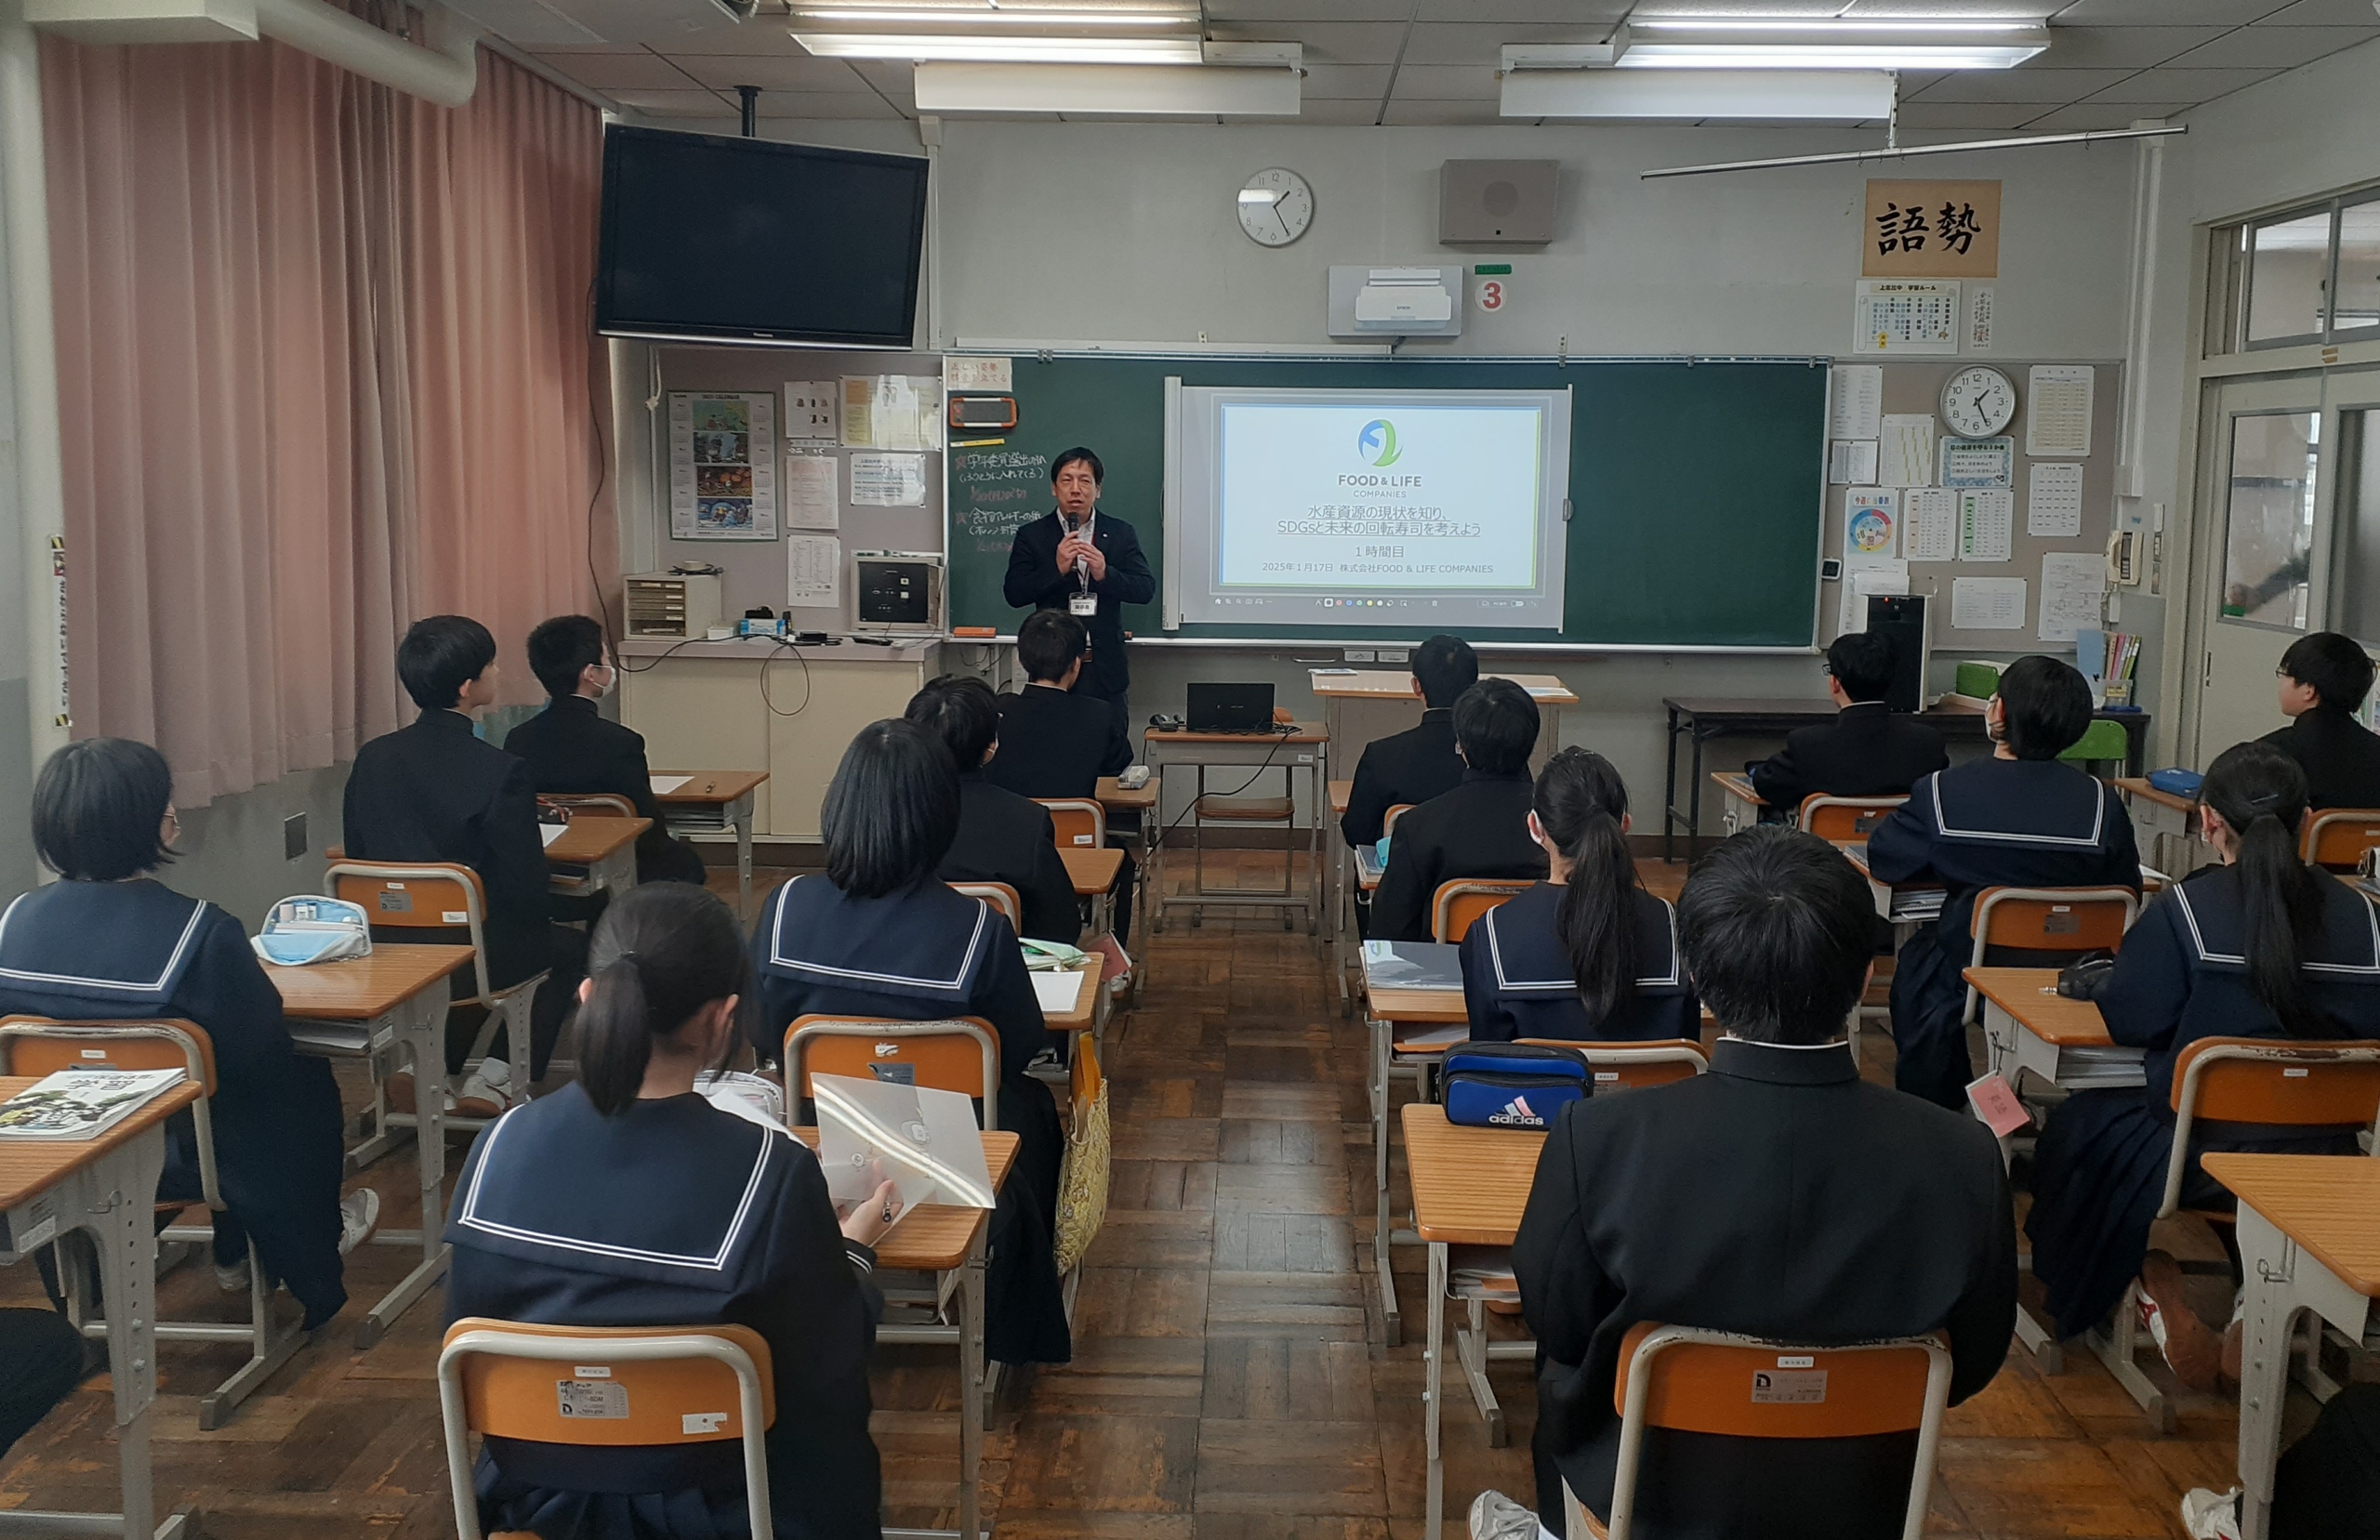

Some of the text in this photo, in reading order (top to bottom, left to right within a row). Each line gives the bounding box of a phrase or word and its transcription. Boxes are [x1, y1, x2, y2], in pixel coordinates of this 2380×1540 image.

[1272, 173, 1280, 182] 12
[1297, 188, 1303, 197] 2
[1302, 204, 1307, 212] 3
[1246, 217, 1251, 226] 8
[1258, 227, 1263, 236] 7
[1270, 231, 1276, 241] 6
[1482, 282, 1501, 309] 3
[1962, 377, 1969, 386] 11
[1973, 374, 1982, 382] 12
[1953, 386, 1963, 394] 10
[1993, 386, 2001, 394] 2
[1949, 398, 1956, 406] 9
[1997, 398, 2004, 406] 3
[1952, 410, 1960, 418] 8
[1962, 418, 1968, 427] 7
[1973, 422, 1979, 430] 6
[1338, 475, 1422, 487] FOOD & LIFE
[1353, 490, 1407, 498] COMPANIES
[1307, 505, 1448, 519] 水産資源の現状を知り、
[1277, 520, 1481, 535] SDGsと未来の回転寿司を考えよう
[1355, 546, 1405, 558] 1時間目
[1262, 562, 1333, 572] 2025年1月17日
[1340, 564, 1403, 573] 株式会社FOOD
[1416, 565, 1436, 573] LIFE
[1438, 565, 1494, 573] COMPANIES
[1488, 1115, 1544, 1125] adidas
